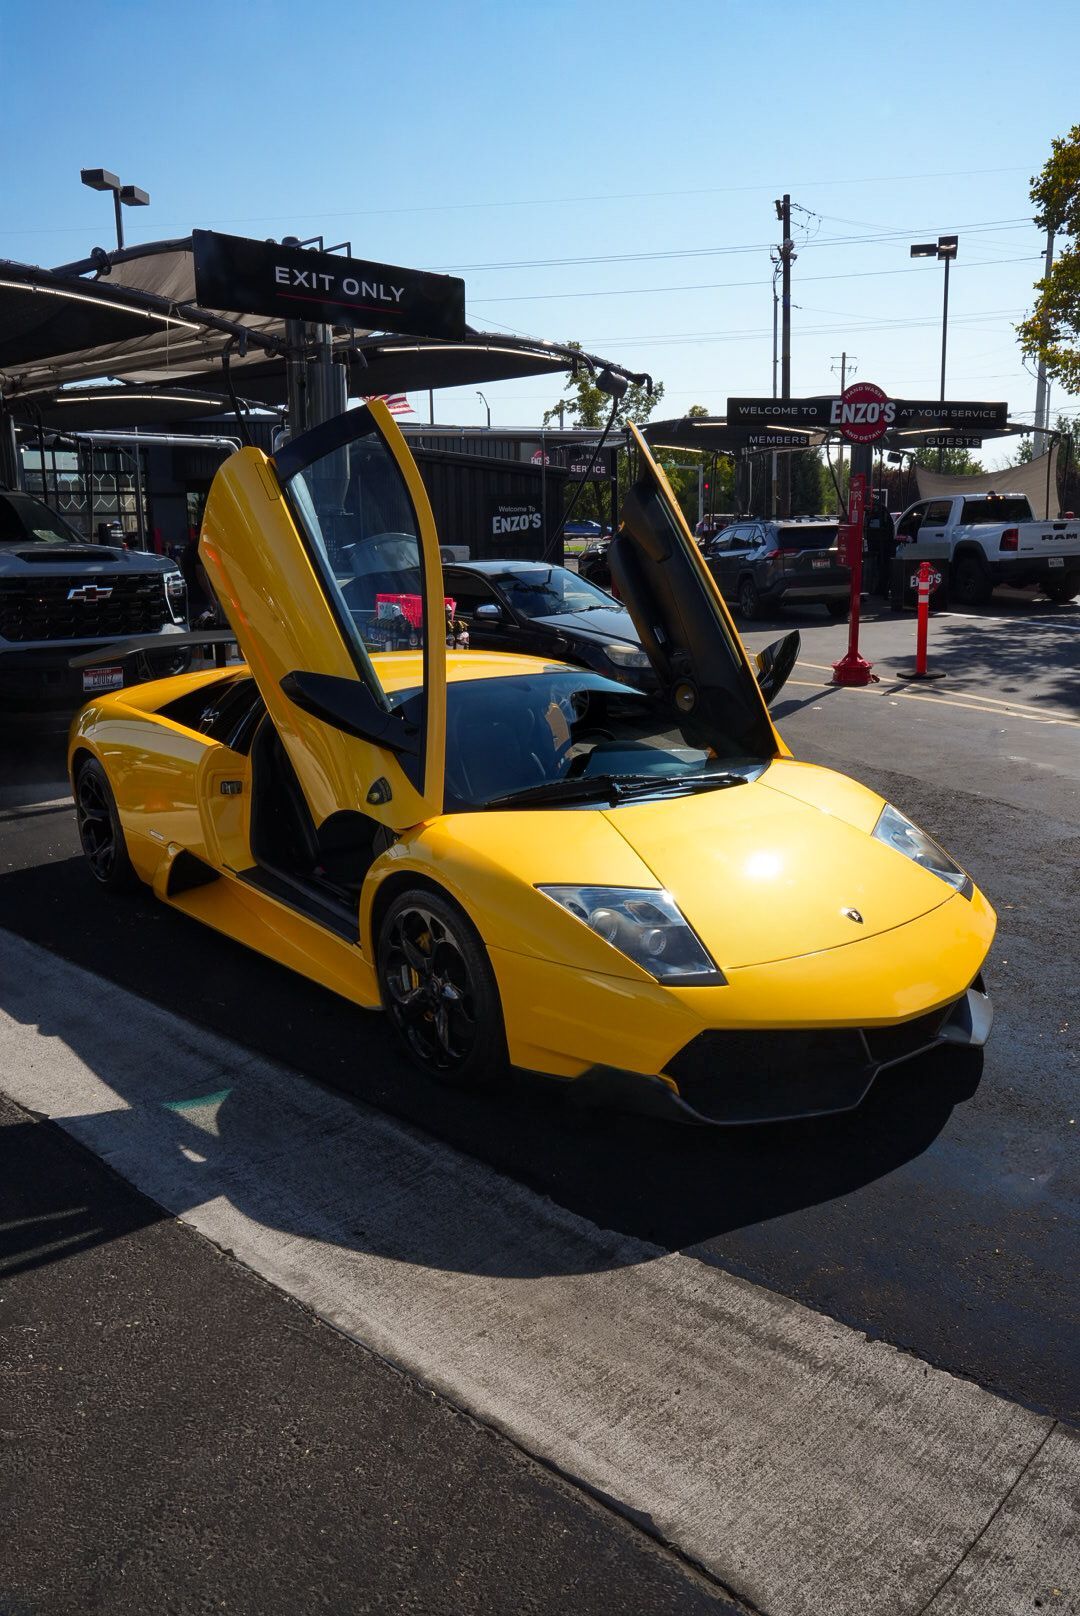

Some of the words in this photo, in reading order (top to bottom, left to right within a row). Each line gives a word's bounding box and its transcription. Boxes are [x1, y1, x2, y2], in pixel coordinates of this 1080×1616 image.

[275, 266, 335, 291] EXIT
[342, 278, 405, 302] ONLY
[739, 406, 798, 415] WELCOME
[800, 407, 818, 415] TO
[830, 400, 896, 424] ENZO'S
[919, 409, 948, 417] YOUR
[951, 410, 997, 418] SERVICE
[749, 435, 807, 444] MEMBERS
[845, 429, 859, 440] AND
[860, 429, 882, 441] DETAIL
[926, 437, 980, 446] GUESTS
[570, 464, 606, 474] SERICE
[492, 512, 542, 534] ENZO'S
[1041, 533, 1078, 541] RAM
